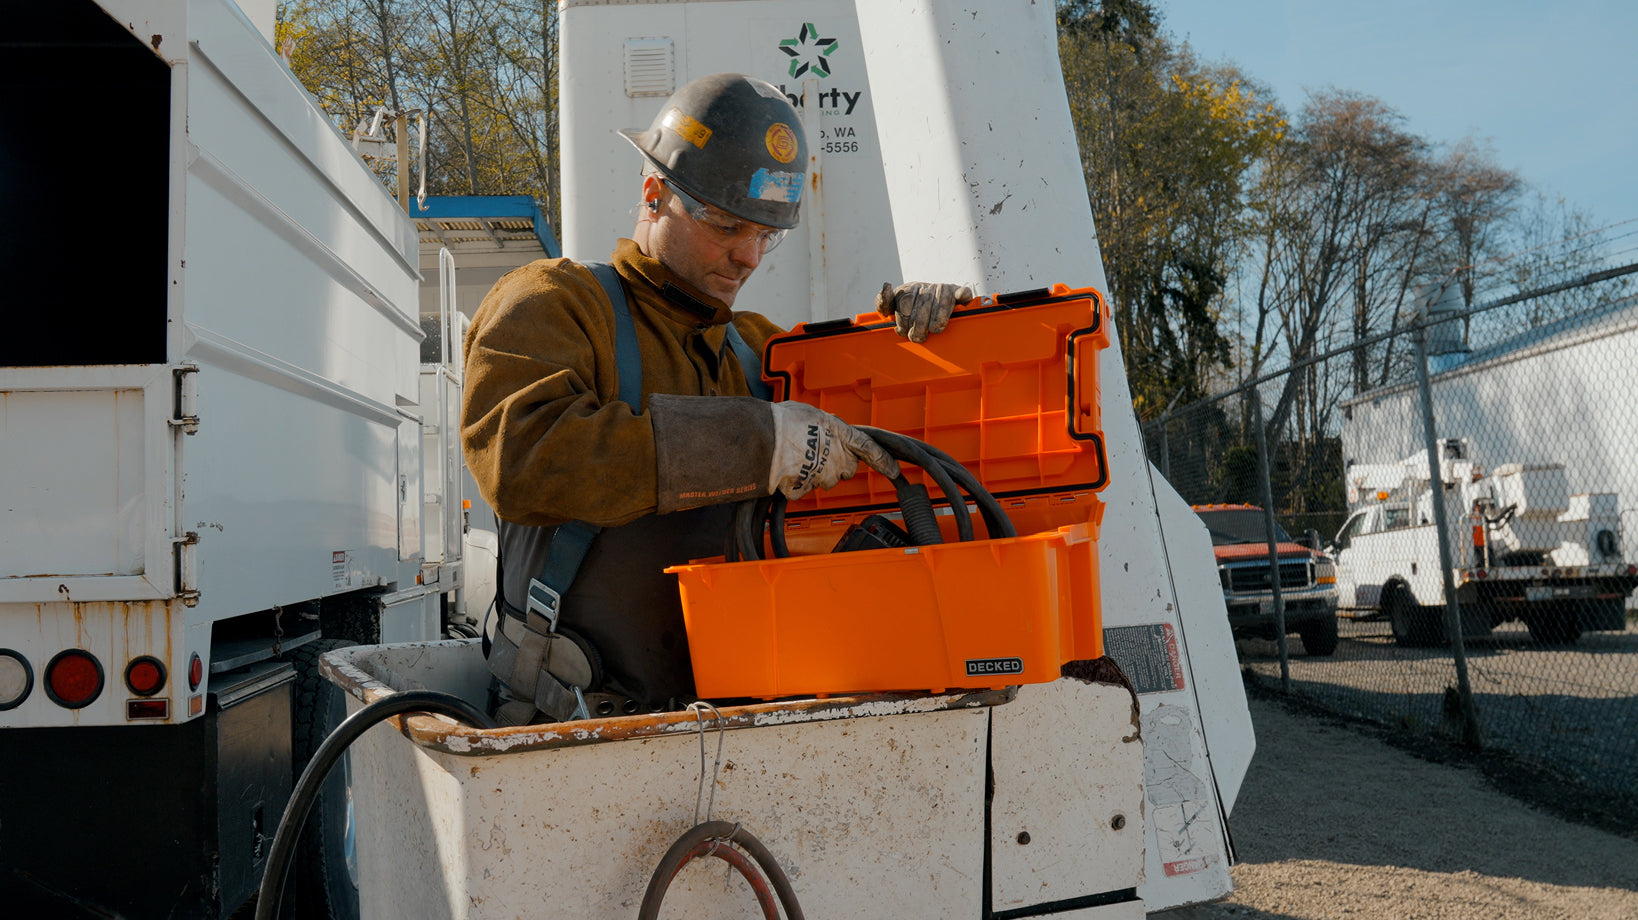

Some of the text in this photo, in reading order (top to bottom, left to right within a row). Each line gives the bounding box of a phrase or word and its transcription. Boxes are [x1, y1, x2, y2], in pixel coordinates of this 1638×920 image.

[834, 127, 856, 137] WA
[792, 424, 819, 490] VULCAN
[968, 661, 1020, 673] DECKED
[1168, 643, 1181, 678] DANGER
